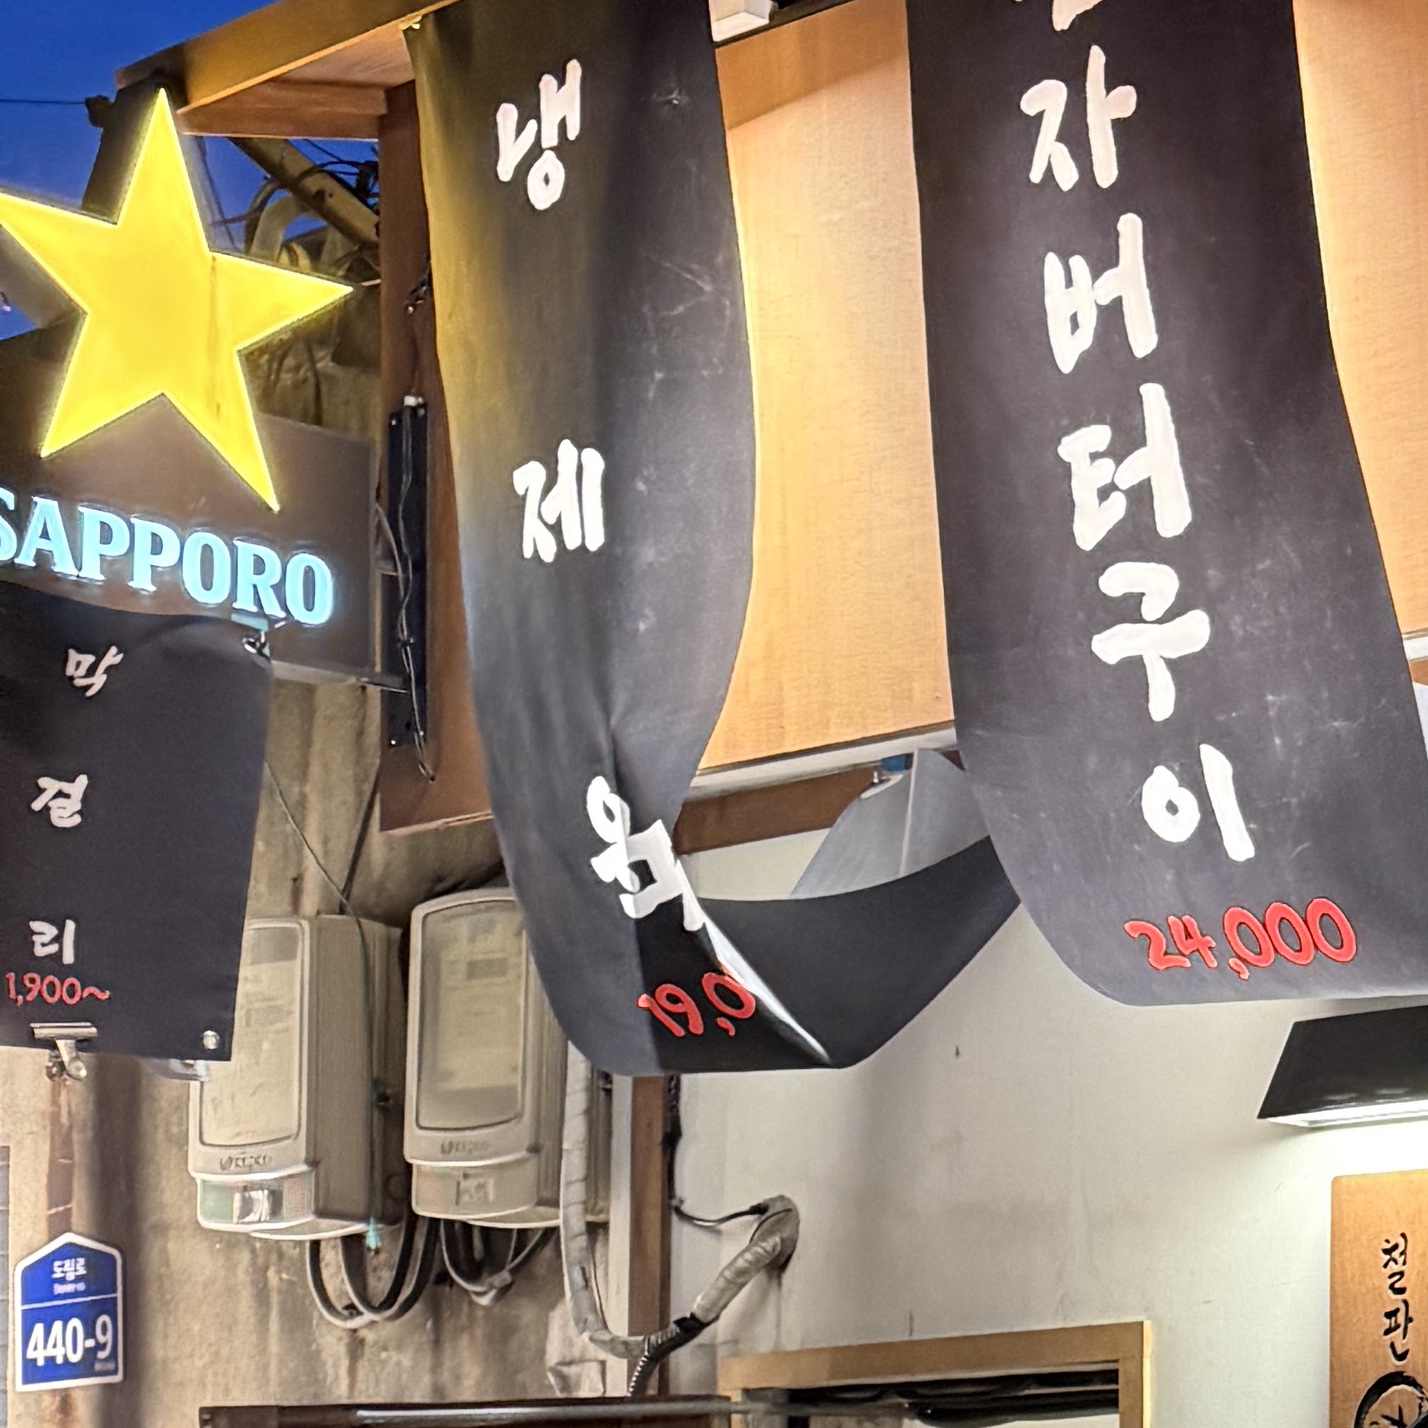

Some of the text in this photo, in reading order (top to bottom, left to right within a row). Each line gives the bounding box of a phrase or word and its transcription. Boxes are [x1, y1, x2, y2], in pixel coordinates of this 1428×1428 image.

[1020, 0, 1256, 862] 자버터구이
[29, 645, 124, 965] 막걸리
[1124, 898, 1356, 980] 24,000
[26, 1315, 113, 1367] 440-9
[1381, 1233, 1412, 1362] 철판
